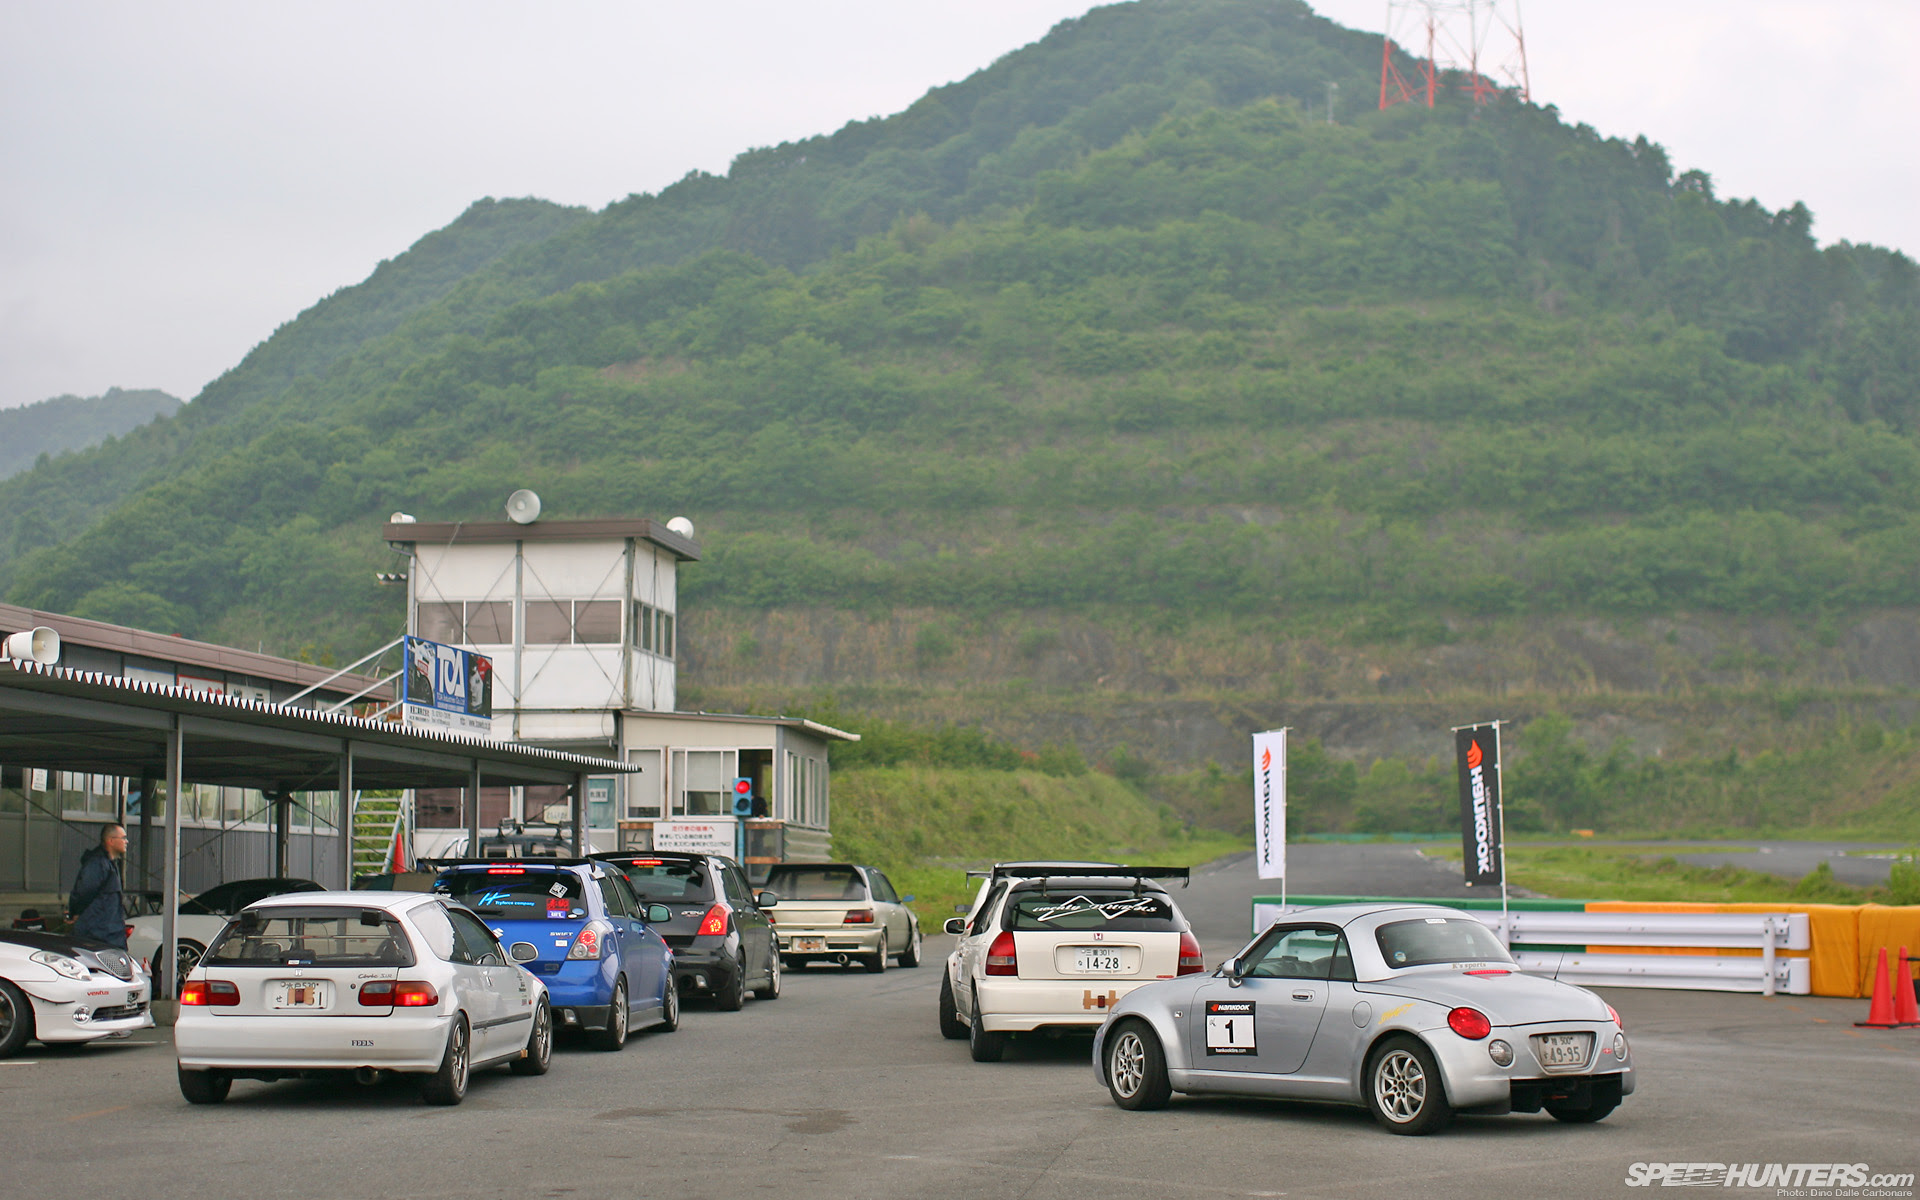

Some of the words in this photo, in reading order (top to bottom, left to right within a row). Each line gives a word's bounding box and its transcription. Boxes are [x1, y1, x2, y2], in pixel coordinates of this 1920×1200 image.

[437, 645, 465, 698] TOA
[1087, 957, 1119, 969] 14-28
[1464, 962, 1487, 970] sports
[1225, 1019, 1234, 1044] 1
[1551, 1046, 1580, 1062] 49-95
